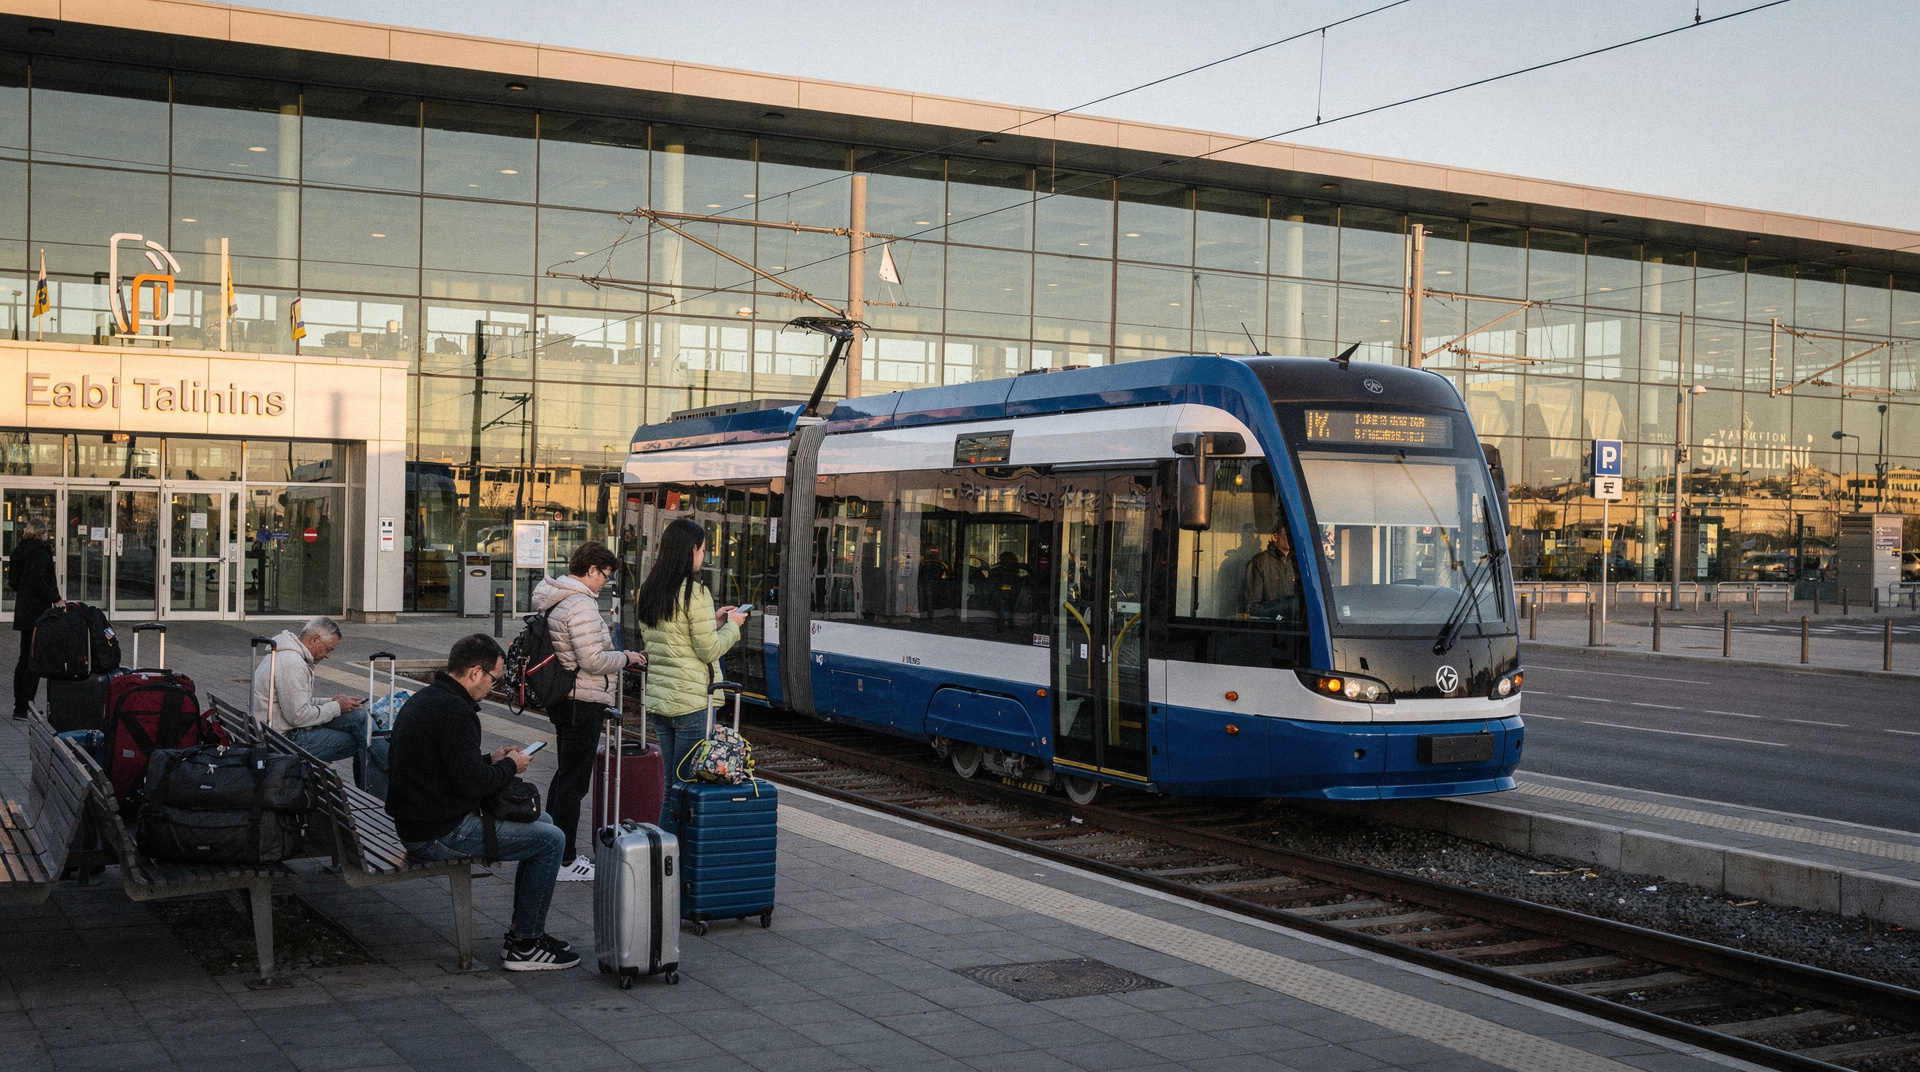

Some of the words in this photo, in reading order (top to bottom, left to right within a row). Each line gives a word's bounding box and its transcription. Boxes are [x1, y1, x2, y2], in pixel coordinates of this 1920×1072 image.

[26, 372, 120, 409] Eabi
[133, 377, 287, 417] Talinins
[1602, 446, 1618, 469] P
